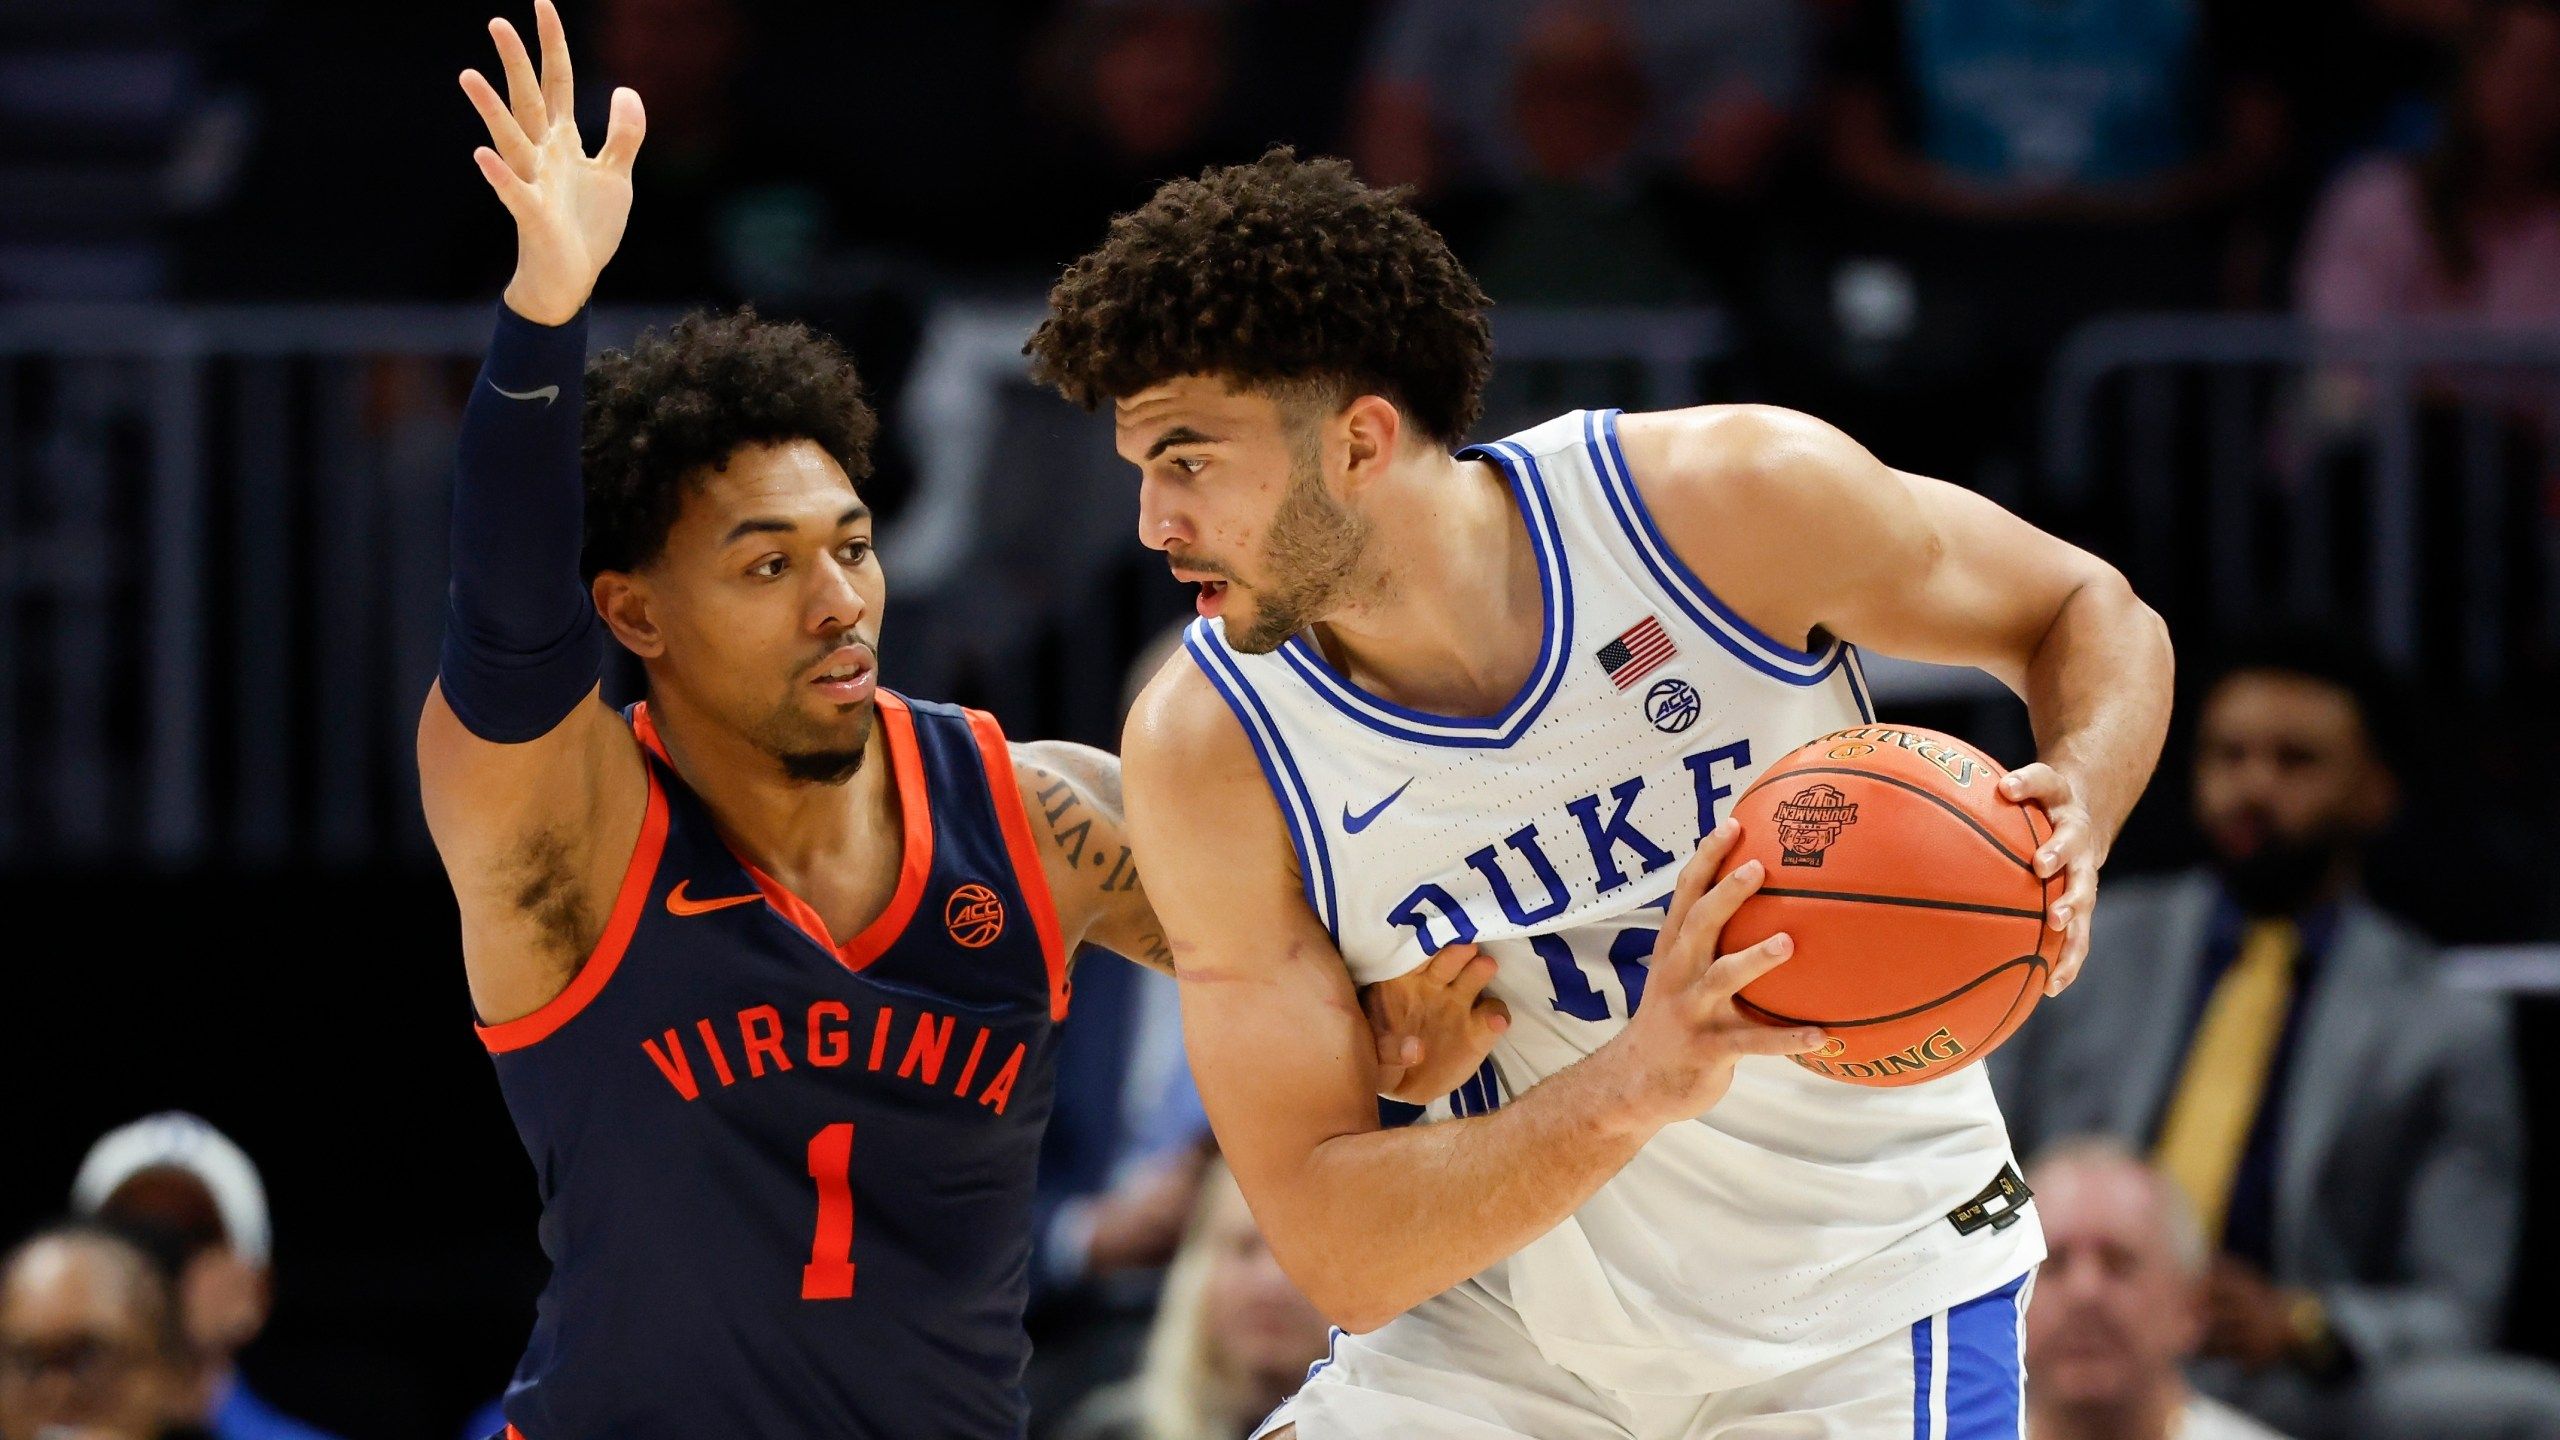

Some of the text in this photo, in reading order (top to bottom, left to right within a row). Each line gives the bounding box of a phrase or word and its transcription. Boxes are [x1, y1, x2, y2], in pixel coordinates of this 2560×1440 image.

[1656, 686, 1694, 719] ACC
[1772, 804, 1858, 824] TOURNAMENT
[1386, 739, 1752, 957] DUKE
[1794, 837, 1816, 845] ACC
[954, 899, 999, 925] ACC
[641, 1000, 1026, 1116] VIRGINIA
[801, 1122, 856, 1300] 1
